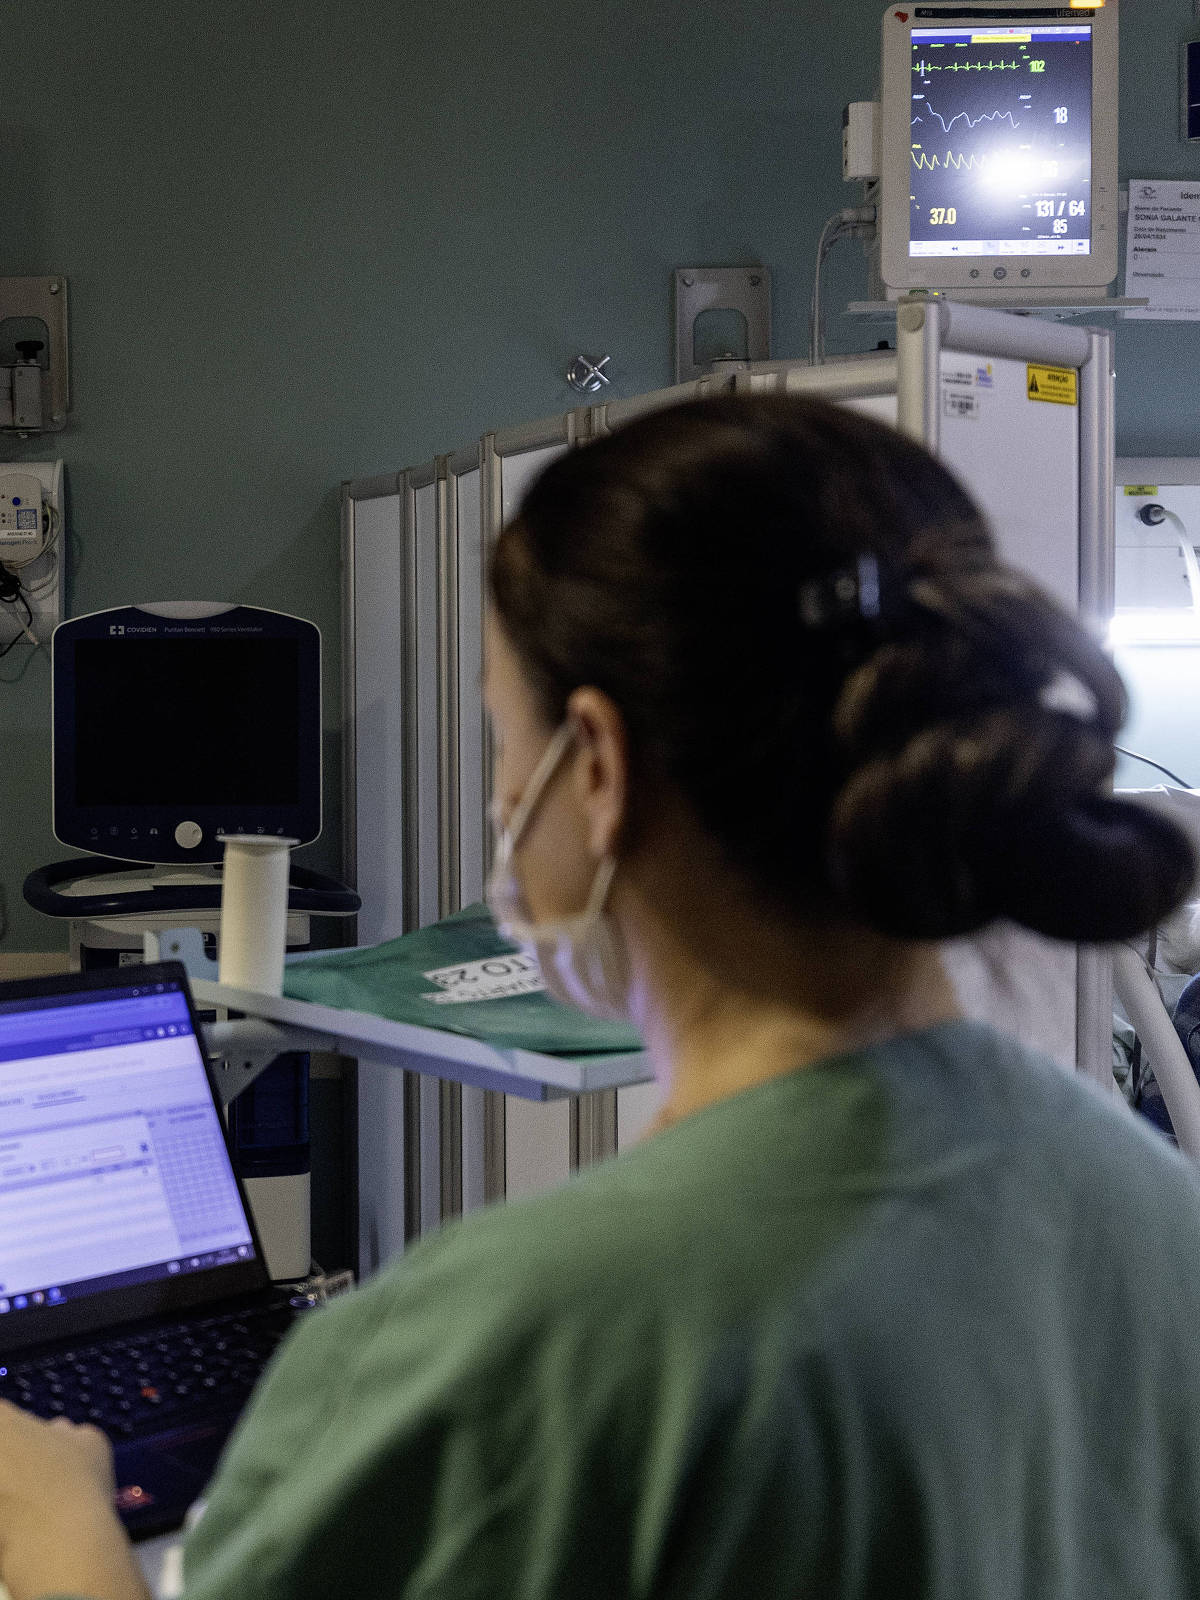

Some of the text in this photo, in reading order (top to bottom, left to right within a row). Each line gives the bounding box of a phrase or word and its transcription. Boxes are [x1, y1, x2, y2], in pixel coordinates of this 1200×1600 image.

[1030, 60, 1046, 73] 102
[1053, 107, 1068, 125] 18
[929, 207, 957, 225] 37.0
[1035, 199, 1055, 217] 131
[1068, 199, 1086, 217] 64
[1053, 218, 1068, 234] 85
